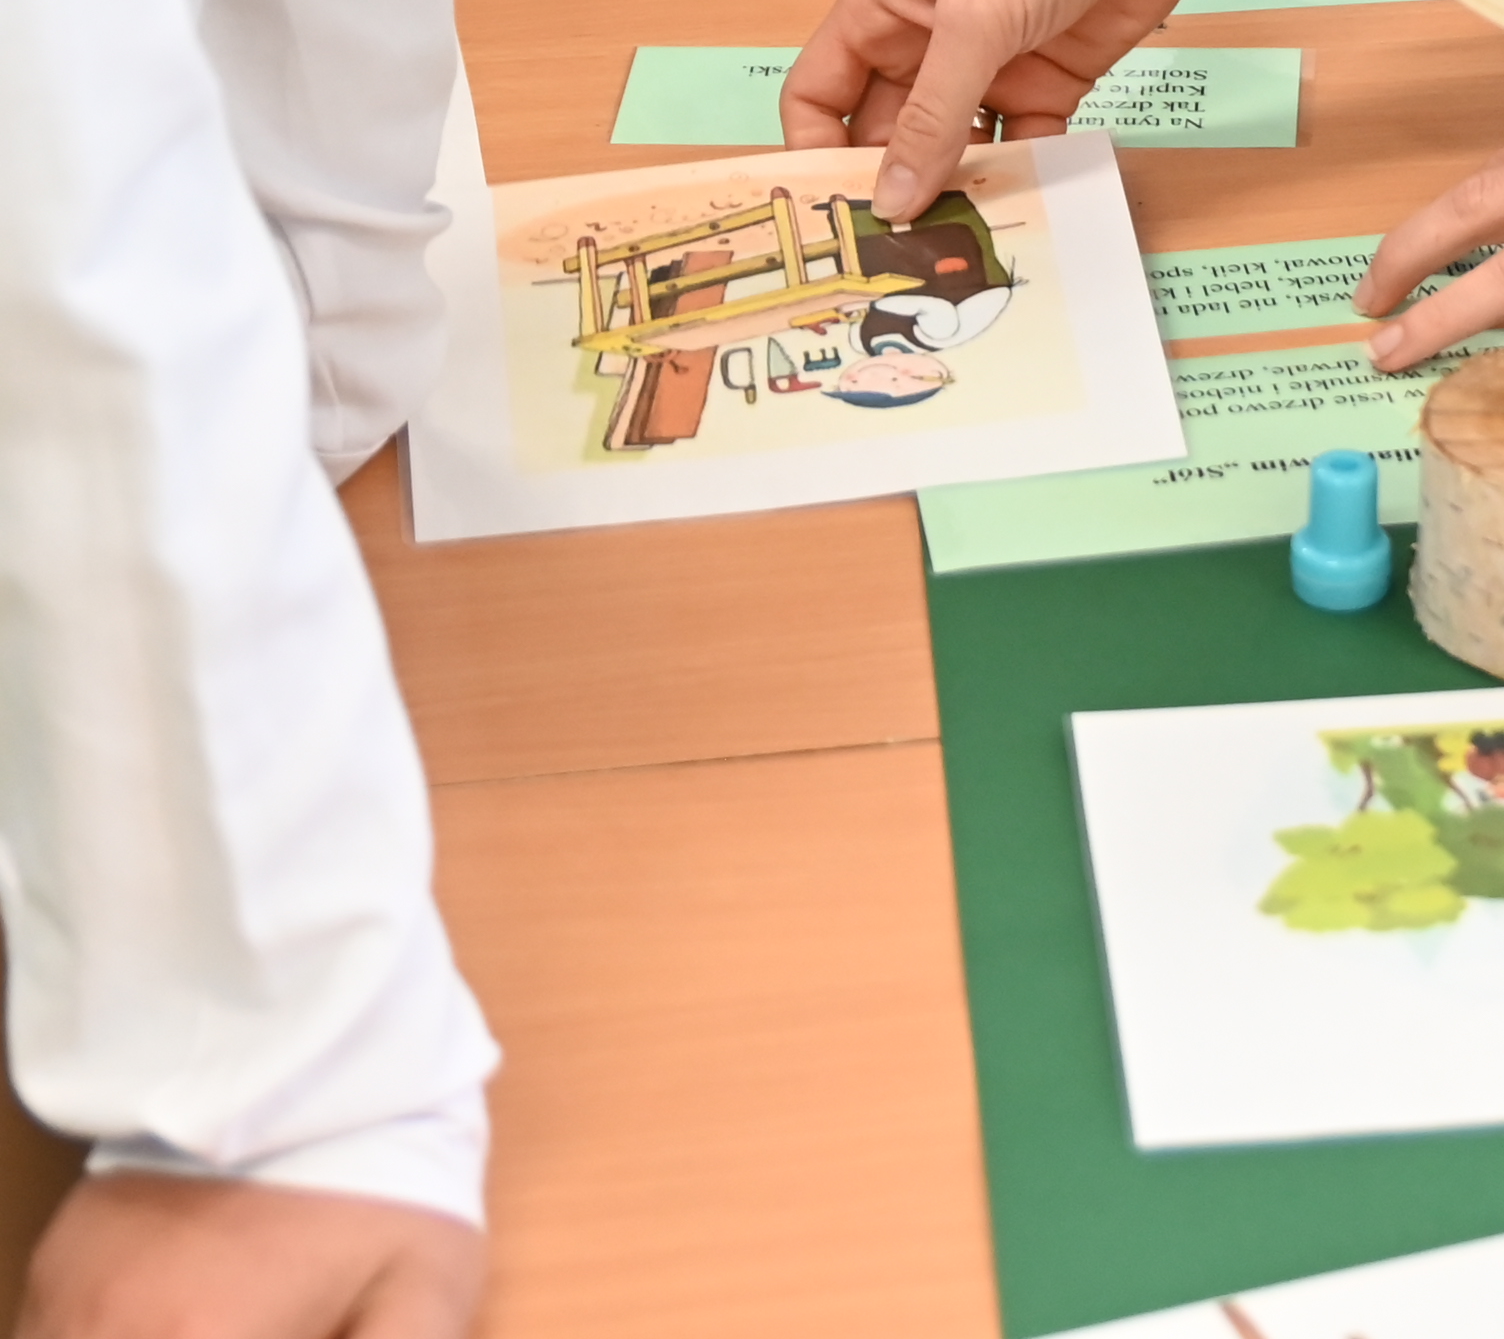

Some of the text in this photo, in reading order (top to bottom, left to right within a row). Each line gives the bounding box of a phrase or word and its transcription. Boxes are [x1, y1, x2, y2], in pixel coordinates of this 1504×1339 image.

[1124, 69, 1208, 81] Stolarz
[1109, 85, 1130, 95] te
[1140, 82, 1206, 97] Kupił
[1079, 101, 1206, 113] Tak drzew
[1114, 114, 1161, 128] tym
[1170, 118, 1203, 130] Na
[1202, 280, 1271, 297] hebel
[1177, 300, 1230, 316] lada
[1238, 297, 1278, 311] nie
[1177, 359, 1360, 384] drwale, drzew
[1333, 390, 1394, 407] lesie
[1227, 397, 1325, 416] drzewo
